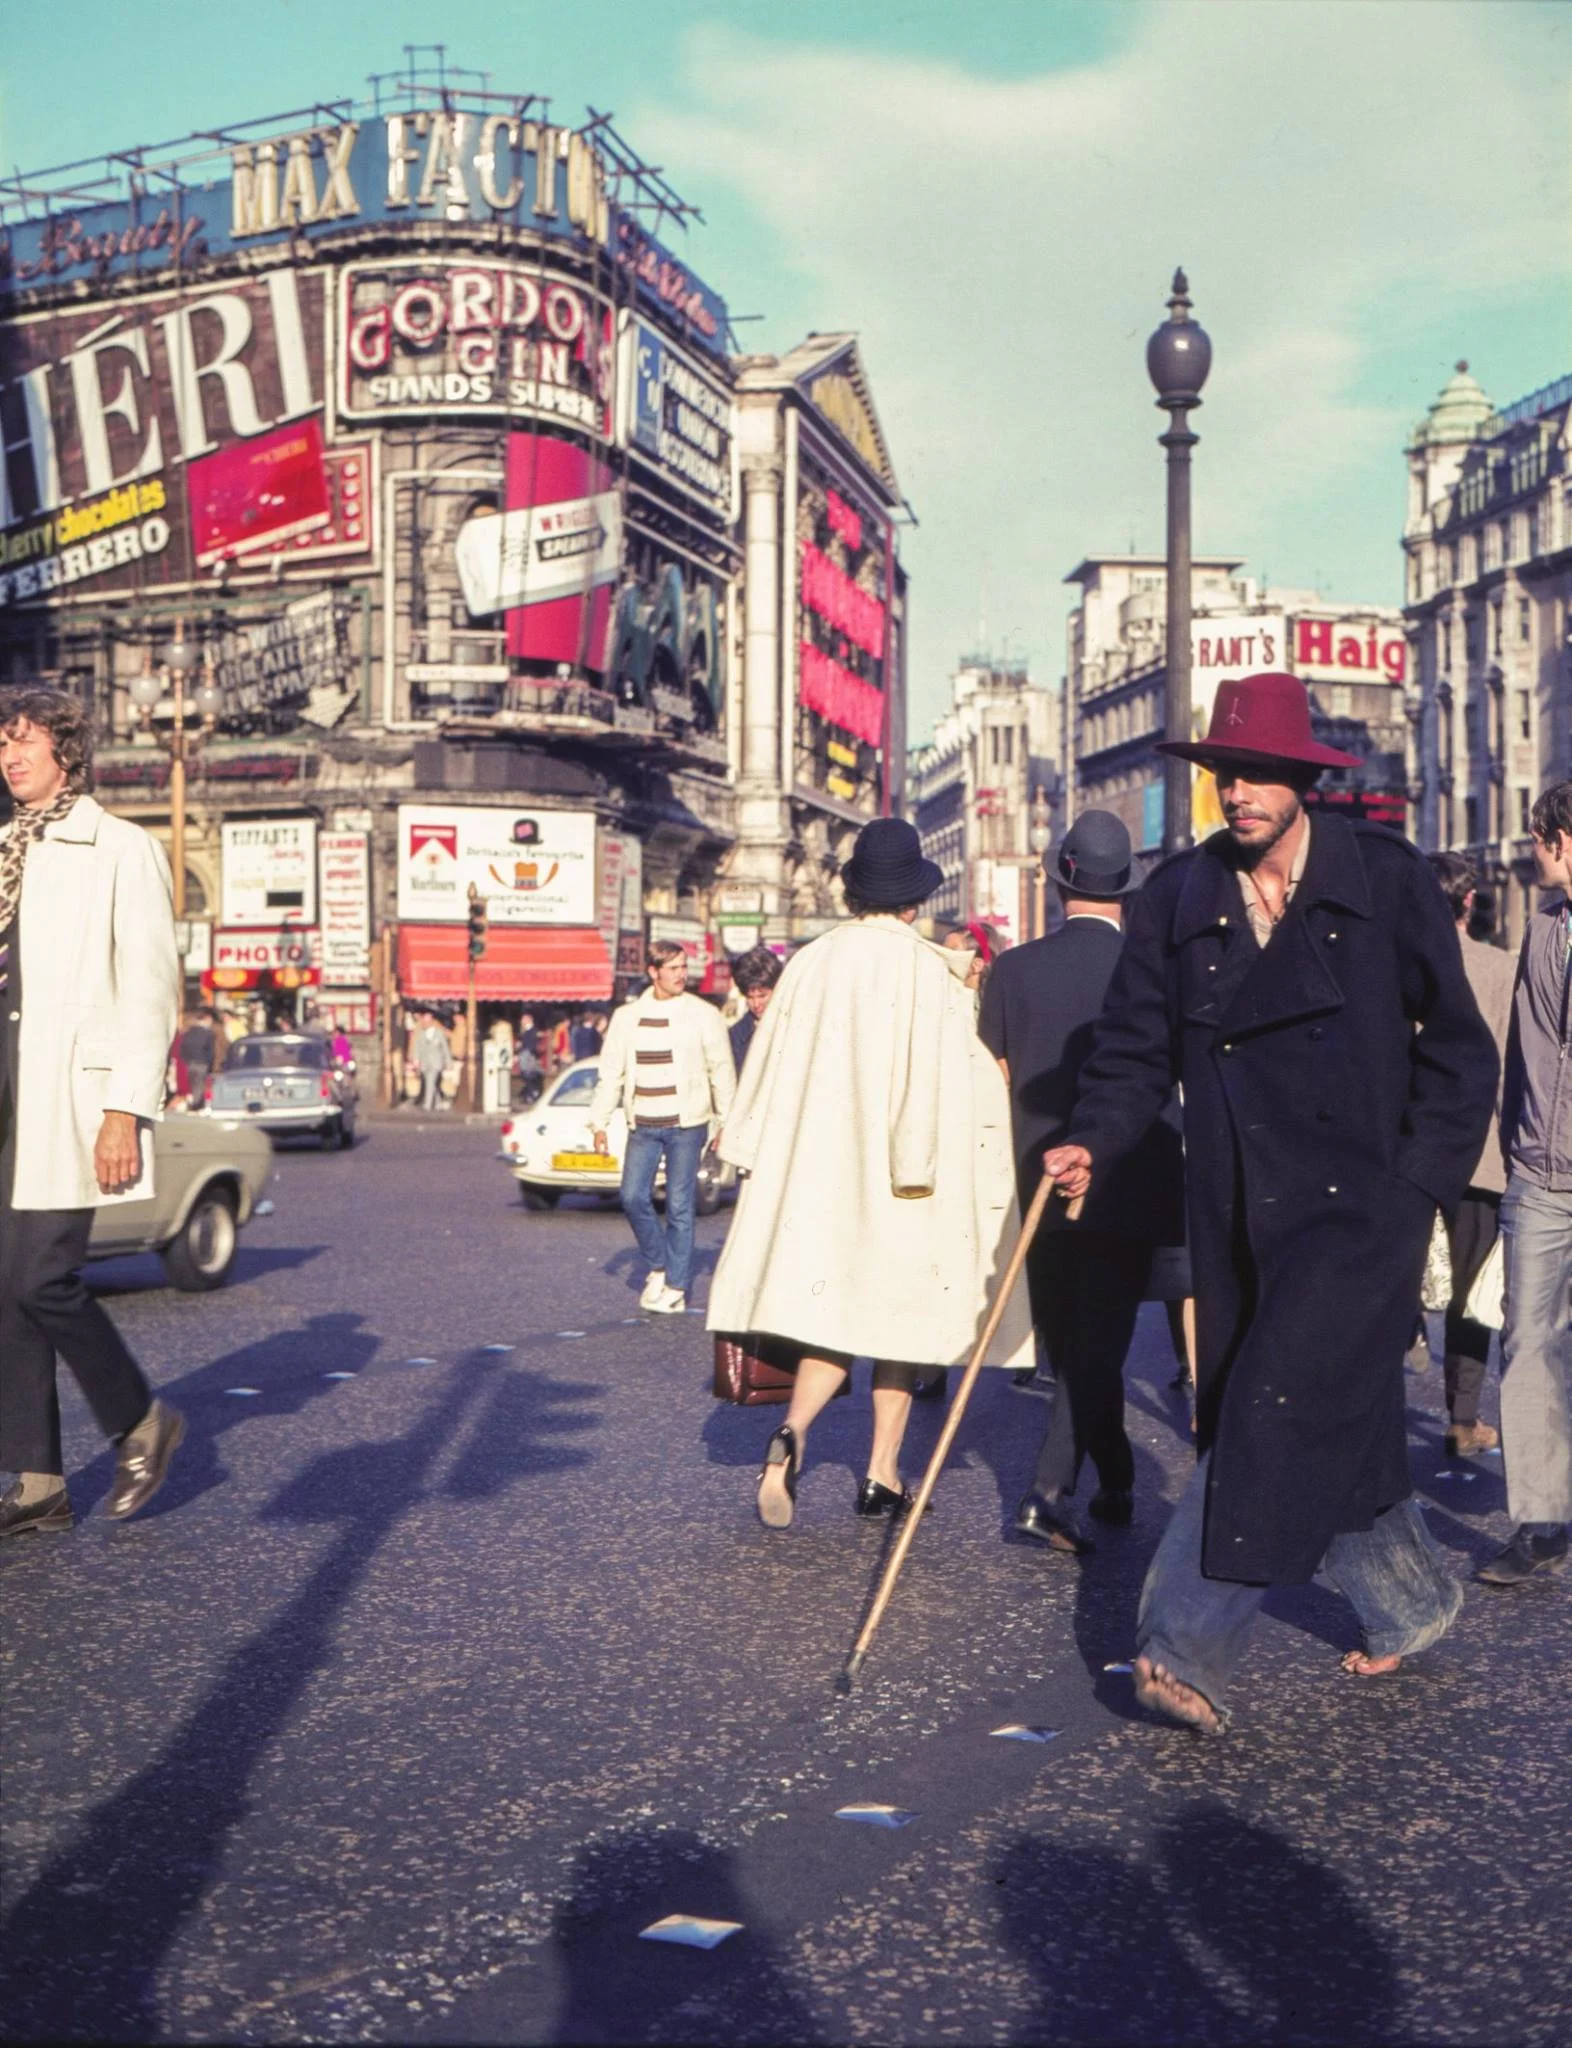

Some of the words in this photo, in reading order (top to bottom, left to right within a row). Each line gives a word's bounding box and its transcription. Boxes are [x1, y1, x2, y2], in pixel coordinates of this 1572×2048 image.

[230, 121, 361, 239] MAX
[457, 332, 571, 385] GIN
[368, 373, 493, 403] STANDS
[55, 479, 166, 545] chocolates
[0, 516, 171, 608] FERRERO
[1192, 627, 1276, 668] RANT'S
[1296, 619, 1406, 683] Haig
[218, 943, 304, 963] PHOTO
